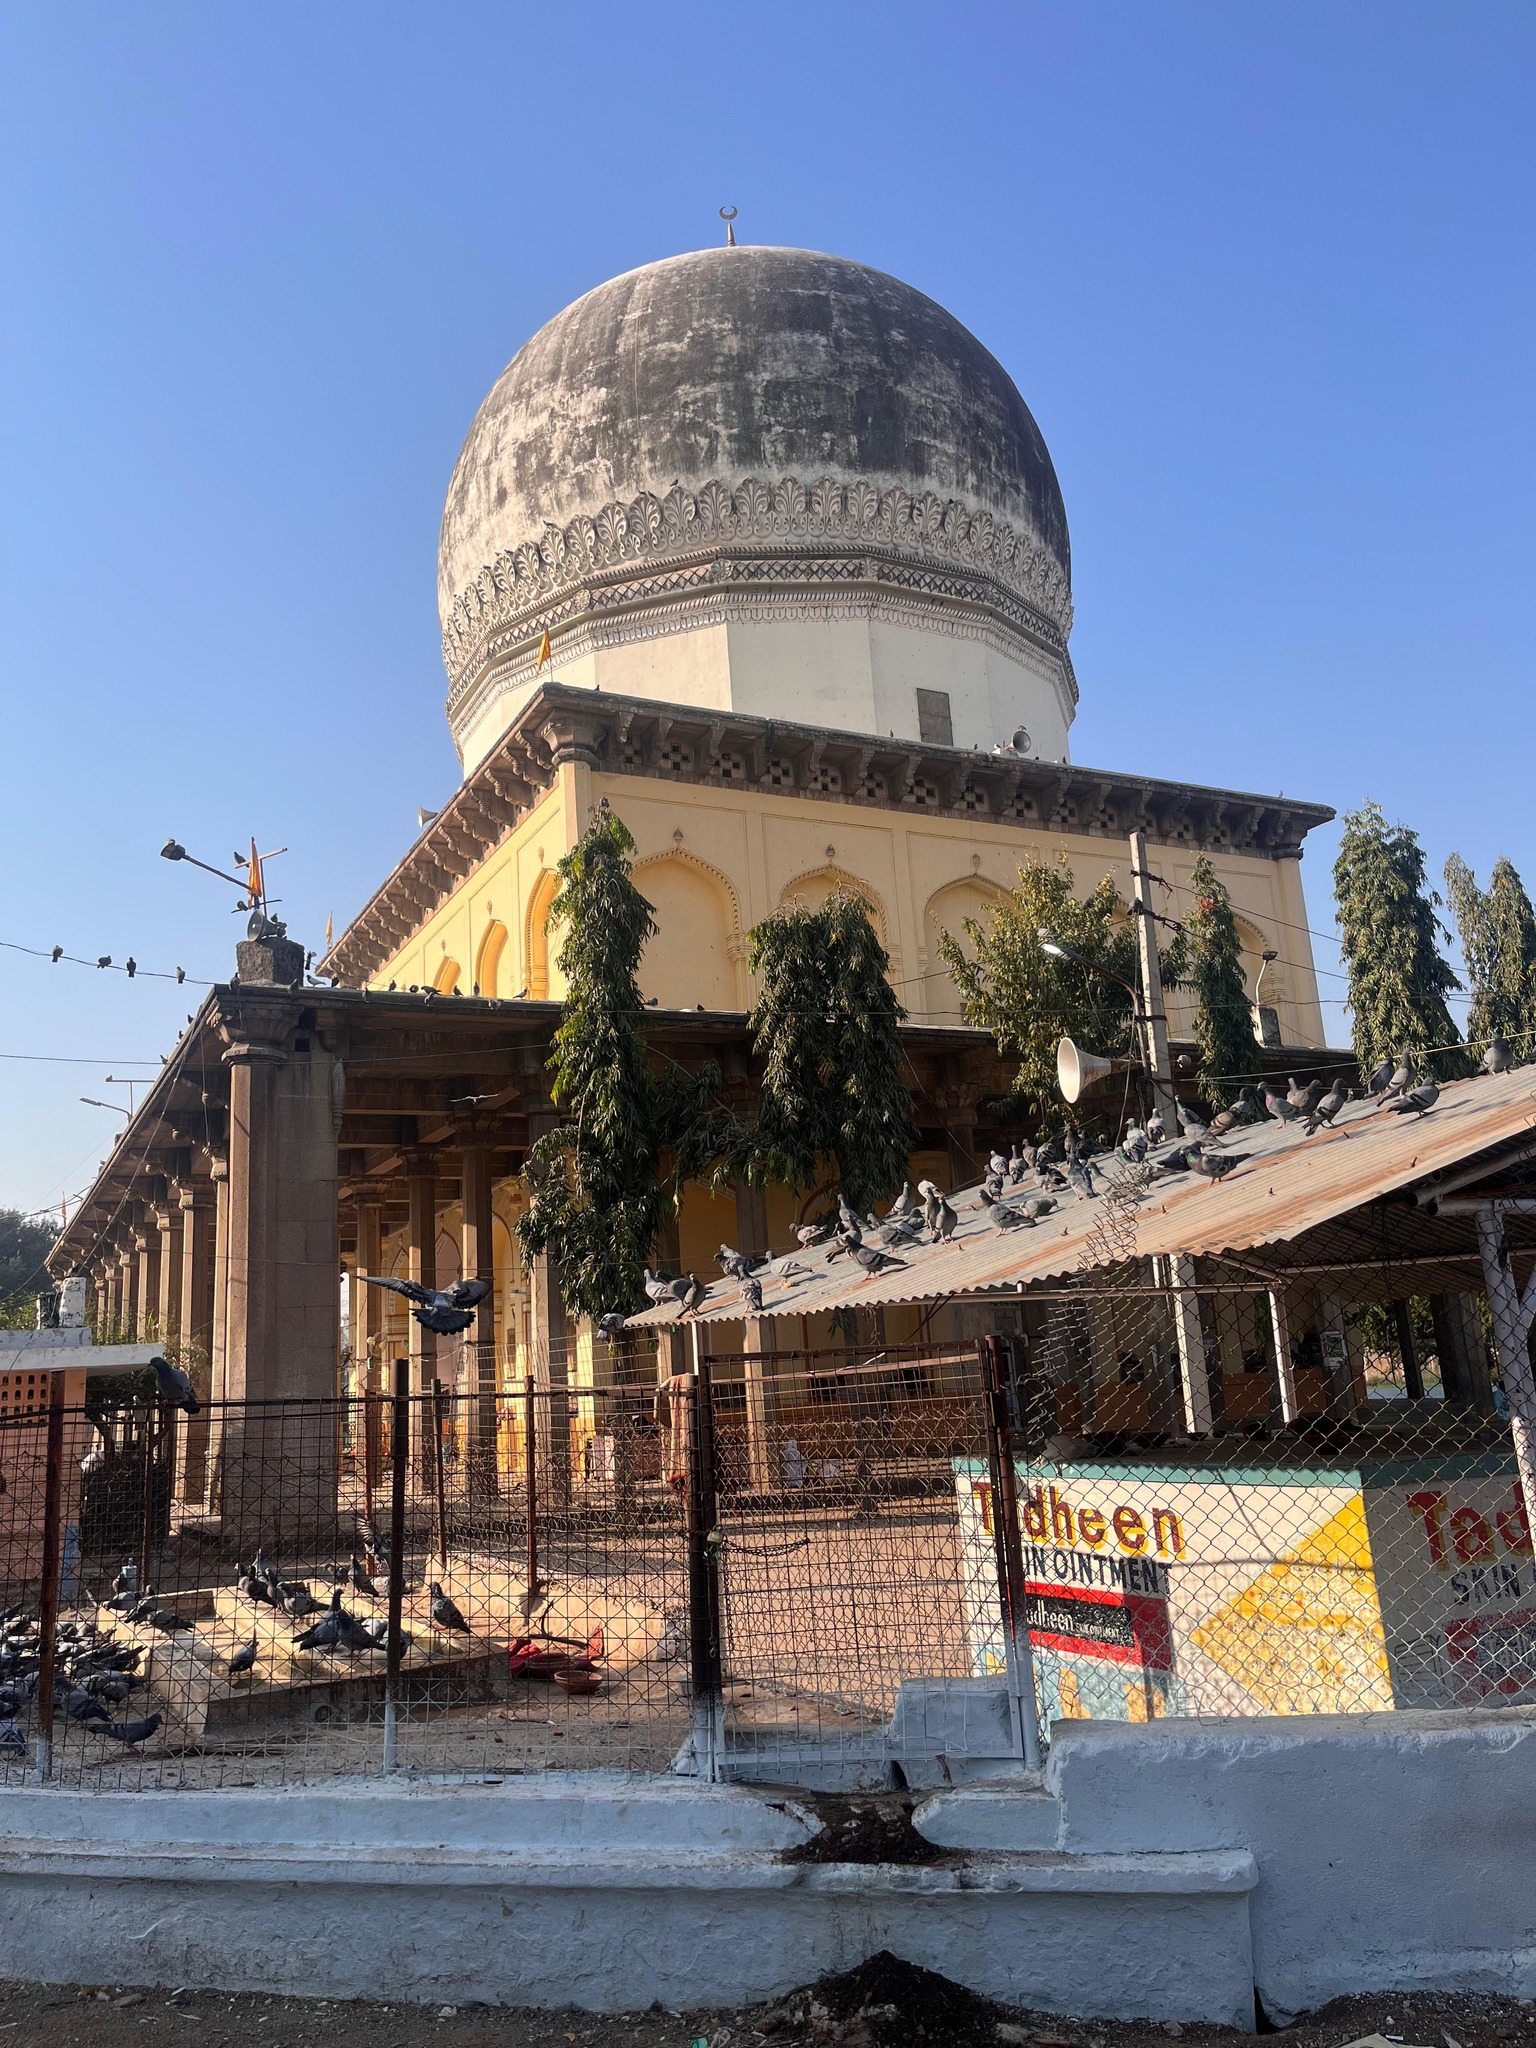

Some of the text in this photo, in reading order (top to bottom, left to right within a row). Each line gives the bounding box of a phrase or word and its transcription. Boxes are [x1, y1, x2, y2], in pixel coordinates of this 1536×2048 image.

[972, 1482, 1185, 1558] Tdheen
[1053, 1550, 1172, 1595] OINTMENT
[1451, 1563, 1520, 1605] SKIN
